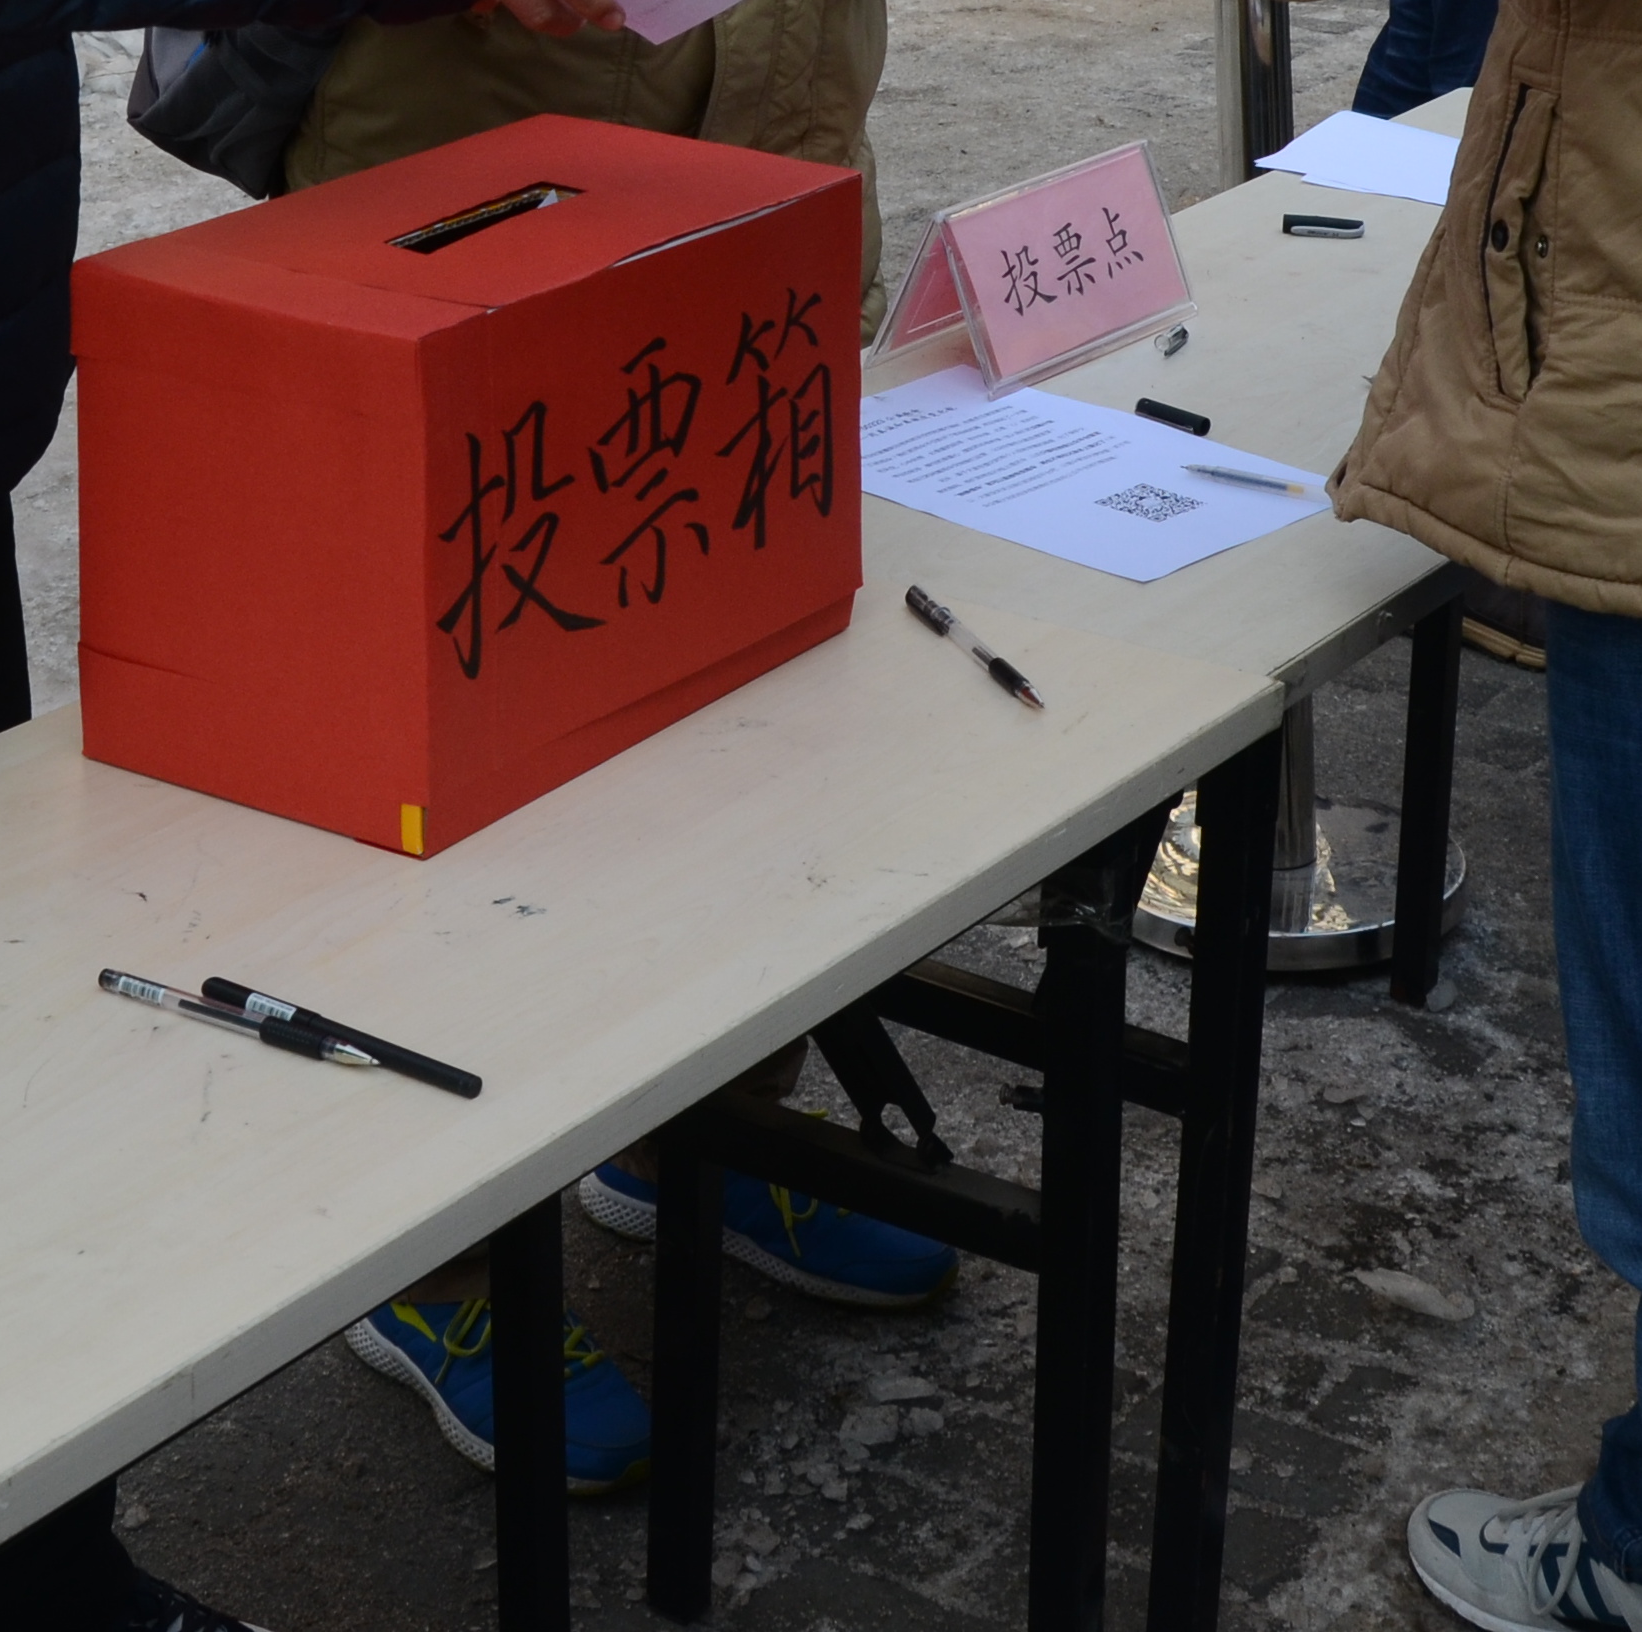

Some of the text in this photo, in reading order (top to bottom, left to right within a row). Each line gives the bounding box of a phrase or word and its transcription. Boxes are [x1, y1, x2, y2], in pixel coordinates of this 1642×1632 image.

[1001, 206, 1145, 317] 投票点
[435, 287, 834, 680] 投票箱
